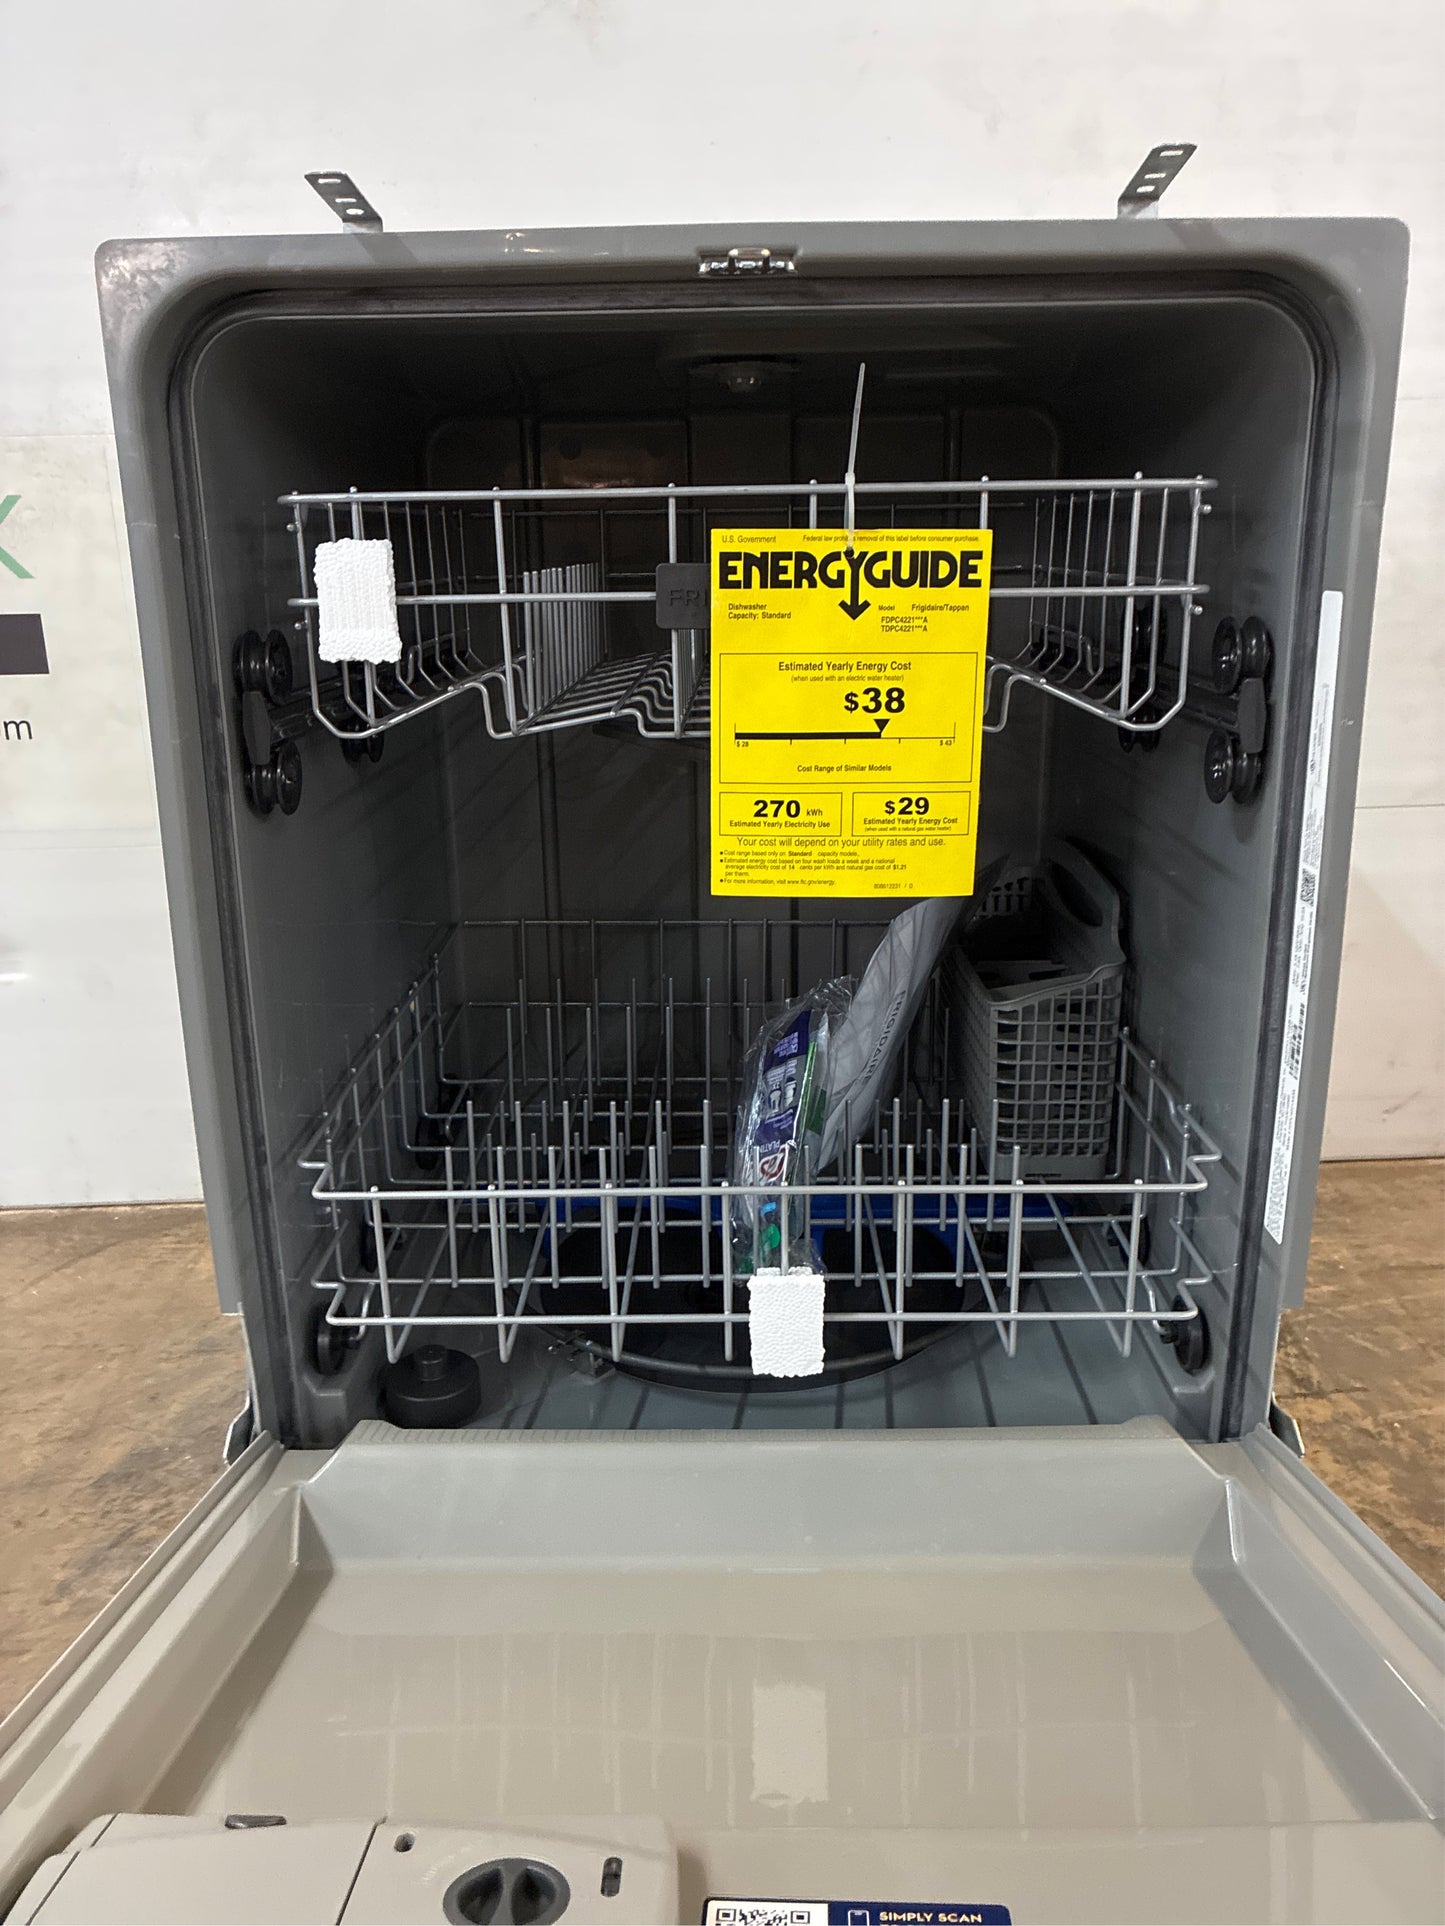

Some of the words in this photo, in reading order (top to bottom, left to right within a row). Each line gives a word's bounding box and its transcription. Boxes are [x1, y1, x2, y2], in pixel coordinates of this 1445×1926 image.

[722, 535, 736, 543] U.S.
[737, 535, 776, 543] Government
[719, 550, 983, 589] ENERGYGUIDE
[728, 603, 767, 611] Dishwasher
[912, 604, 969, 612] Frigidaire/Tappan
[728, 611, 759, 620] Capacity:
[761, 611, 792, 619] Standard
[778, 661, 823, 671] Estimated
[826, 661, 854, 673] Yearly
[856, 661, 888, 673] Energy
[890, 661, 912, 671] Cost
[791, 675, 808, 683] (when
[884, 674, 904, 682] heater)
[844, 687, 905, 714] $38
[814, 765, 835, 773] Range
[836, 764, 843, 772] of
[844, 764, 866, 772] Similar
[753, 799, 801, 818] 270
[806, 808, 823, 817] kWh
[884, 797, 930, 816] $29
[729, 820, 761, 828] Estimated
[763, 820, 782, 829] Yearly
[784, 821, 816, 829] Electricity
[863, 817, 895, 825] Estimated
[897, 817, 917, 826] Yearly
[919, 817, 941, 826] Energy
[737, 836, 756, 846] Your
[758, 837, 777, 846] cost
[779, 837, 792, 846] will
[794, 837, 826, 848] depend
[841, 838, 860, 849] your
[862, 838, 884, 848] utility
[886, 838, 908, 846] rates
[909, 837, 926, 846] and
[928, 838, 946, 846] use.
[862, 990, 906, 1086] FRIGIDAIRE
[879, 1911, 933, 1922] SIMPLY
[938, 1913, 983, 1923] SCAN
